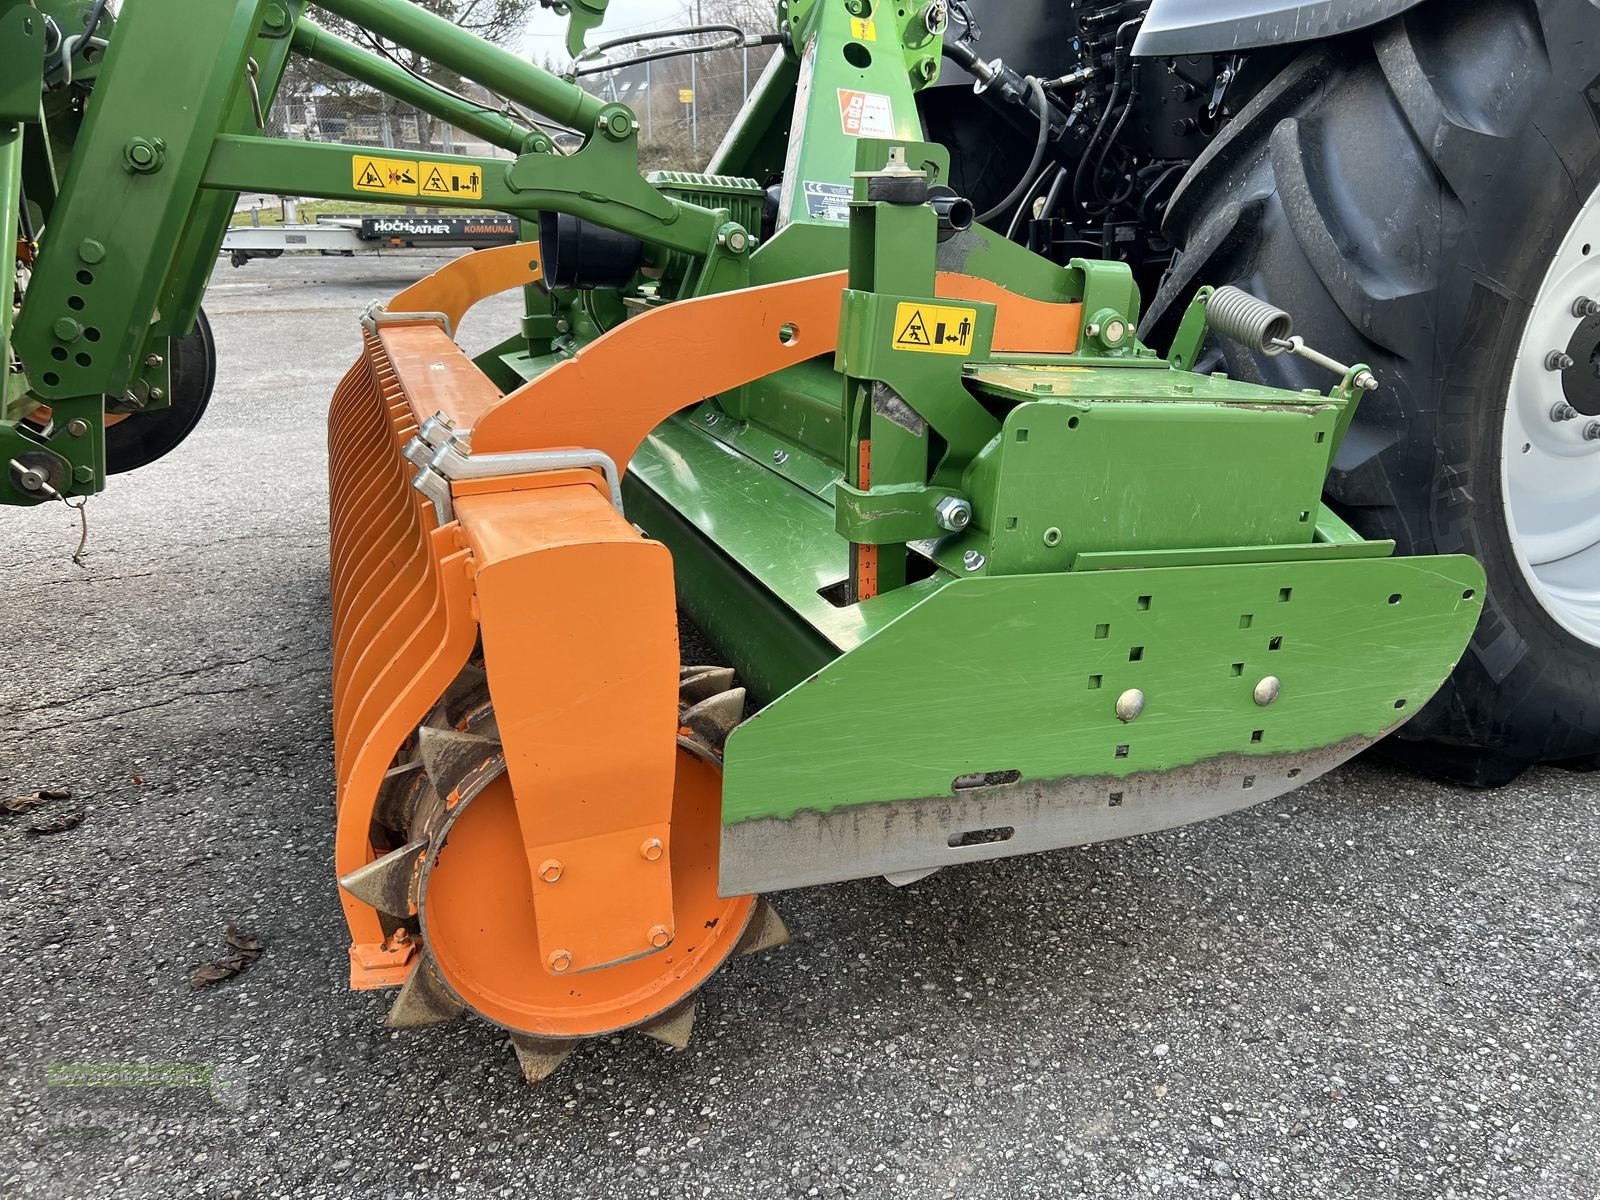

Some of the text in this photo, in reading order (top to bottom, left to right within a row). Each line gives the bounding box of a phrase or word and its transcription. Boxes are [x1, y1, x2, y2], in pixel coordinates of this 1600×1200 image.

[808, 183, 823, 193] CE
[374, 222, 513, 234] HOCHRATHER KOMMUNAL
